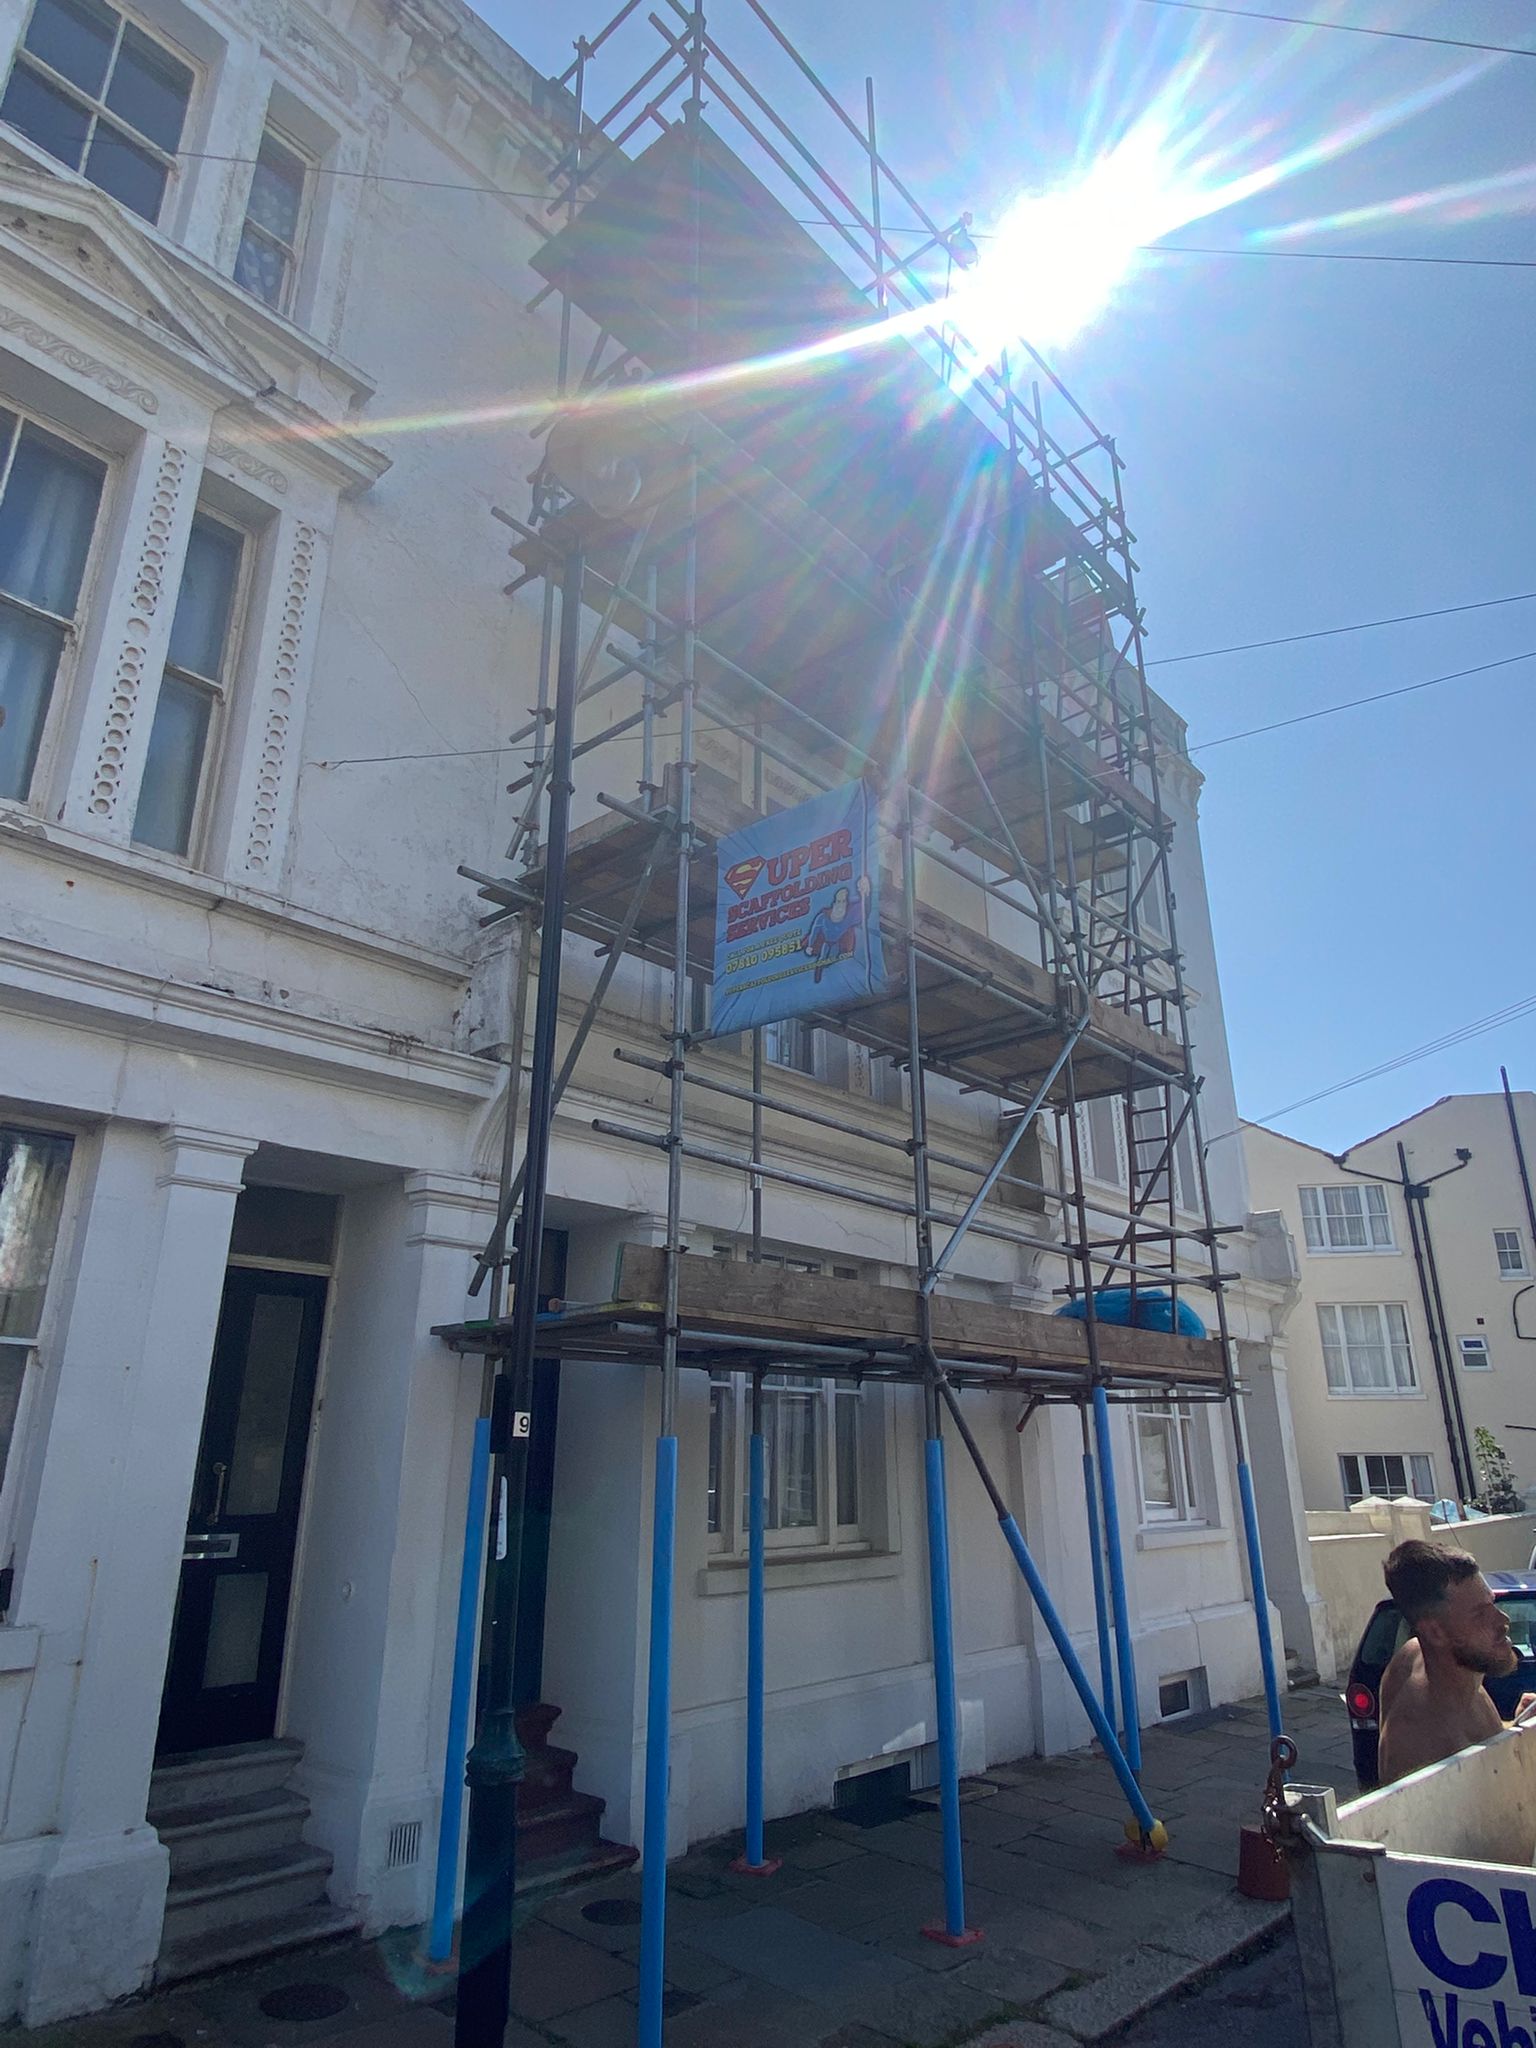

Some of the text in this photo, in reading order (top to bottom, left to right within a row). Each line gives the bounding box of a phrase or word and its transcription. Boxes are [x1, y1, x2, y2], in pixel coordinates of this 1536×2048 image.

[727, 862, 852, 924] SCAFFOLDING
[726, 897, 811, 943] SERVICES
[726, 954, 758, 975] 07810
[520, 1416, 529, 1433] 9
